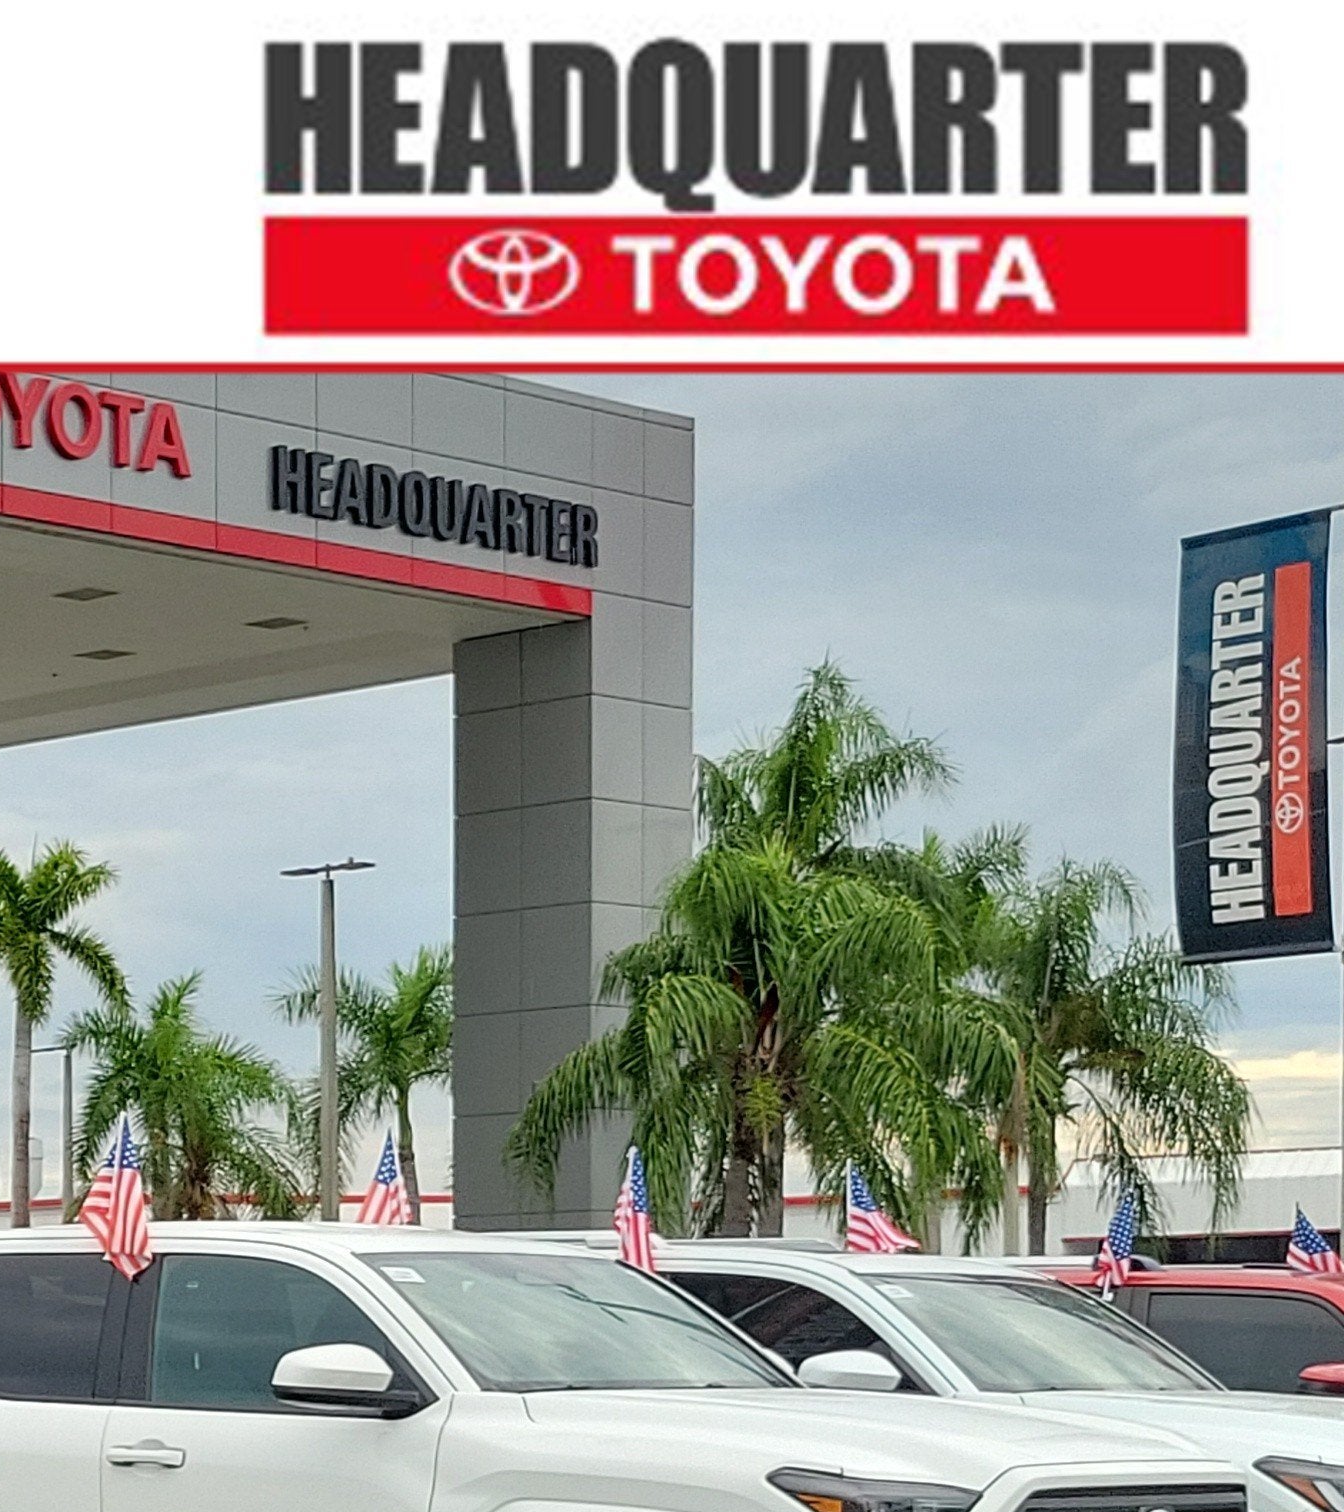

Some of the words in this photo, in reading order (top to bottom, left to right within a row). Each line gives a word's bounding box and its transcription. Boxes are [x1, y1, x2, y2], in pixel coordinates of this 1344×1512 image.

[269, 445, 599, 568] HEADQUARTER
[1207, 573, 1270, 924] HEADQUARTER
[1277, 656, 1301, 790] TOYOTA
